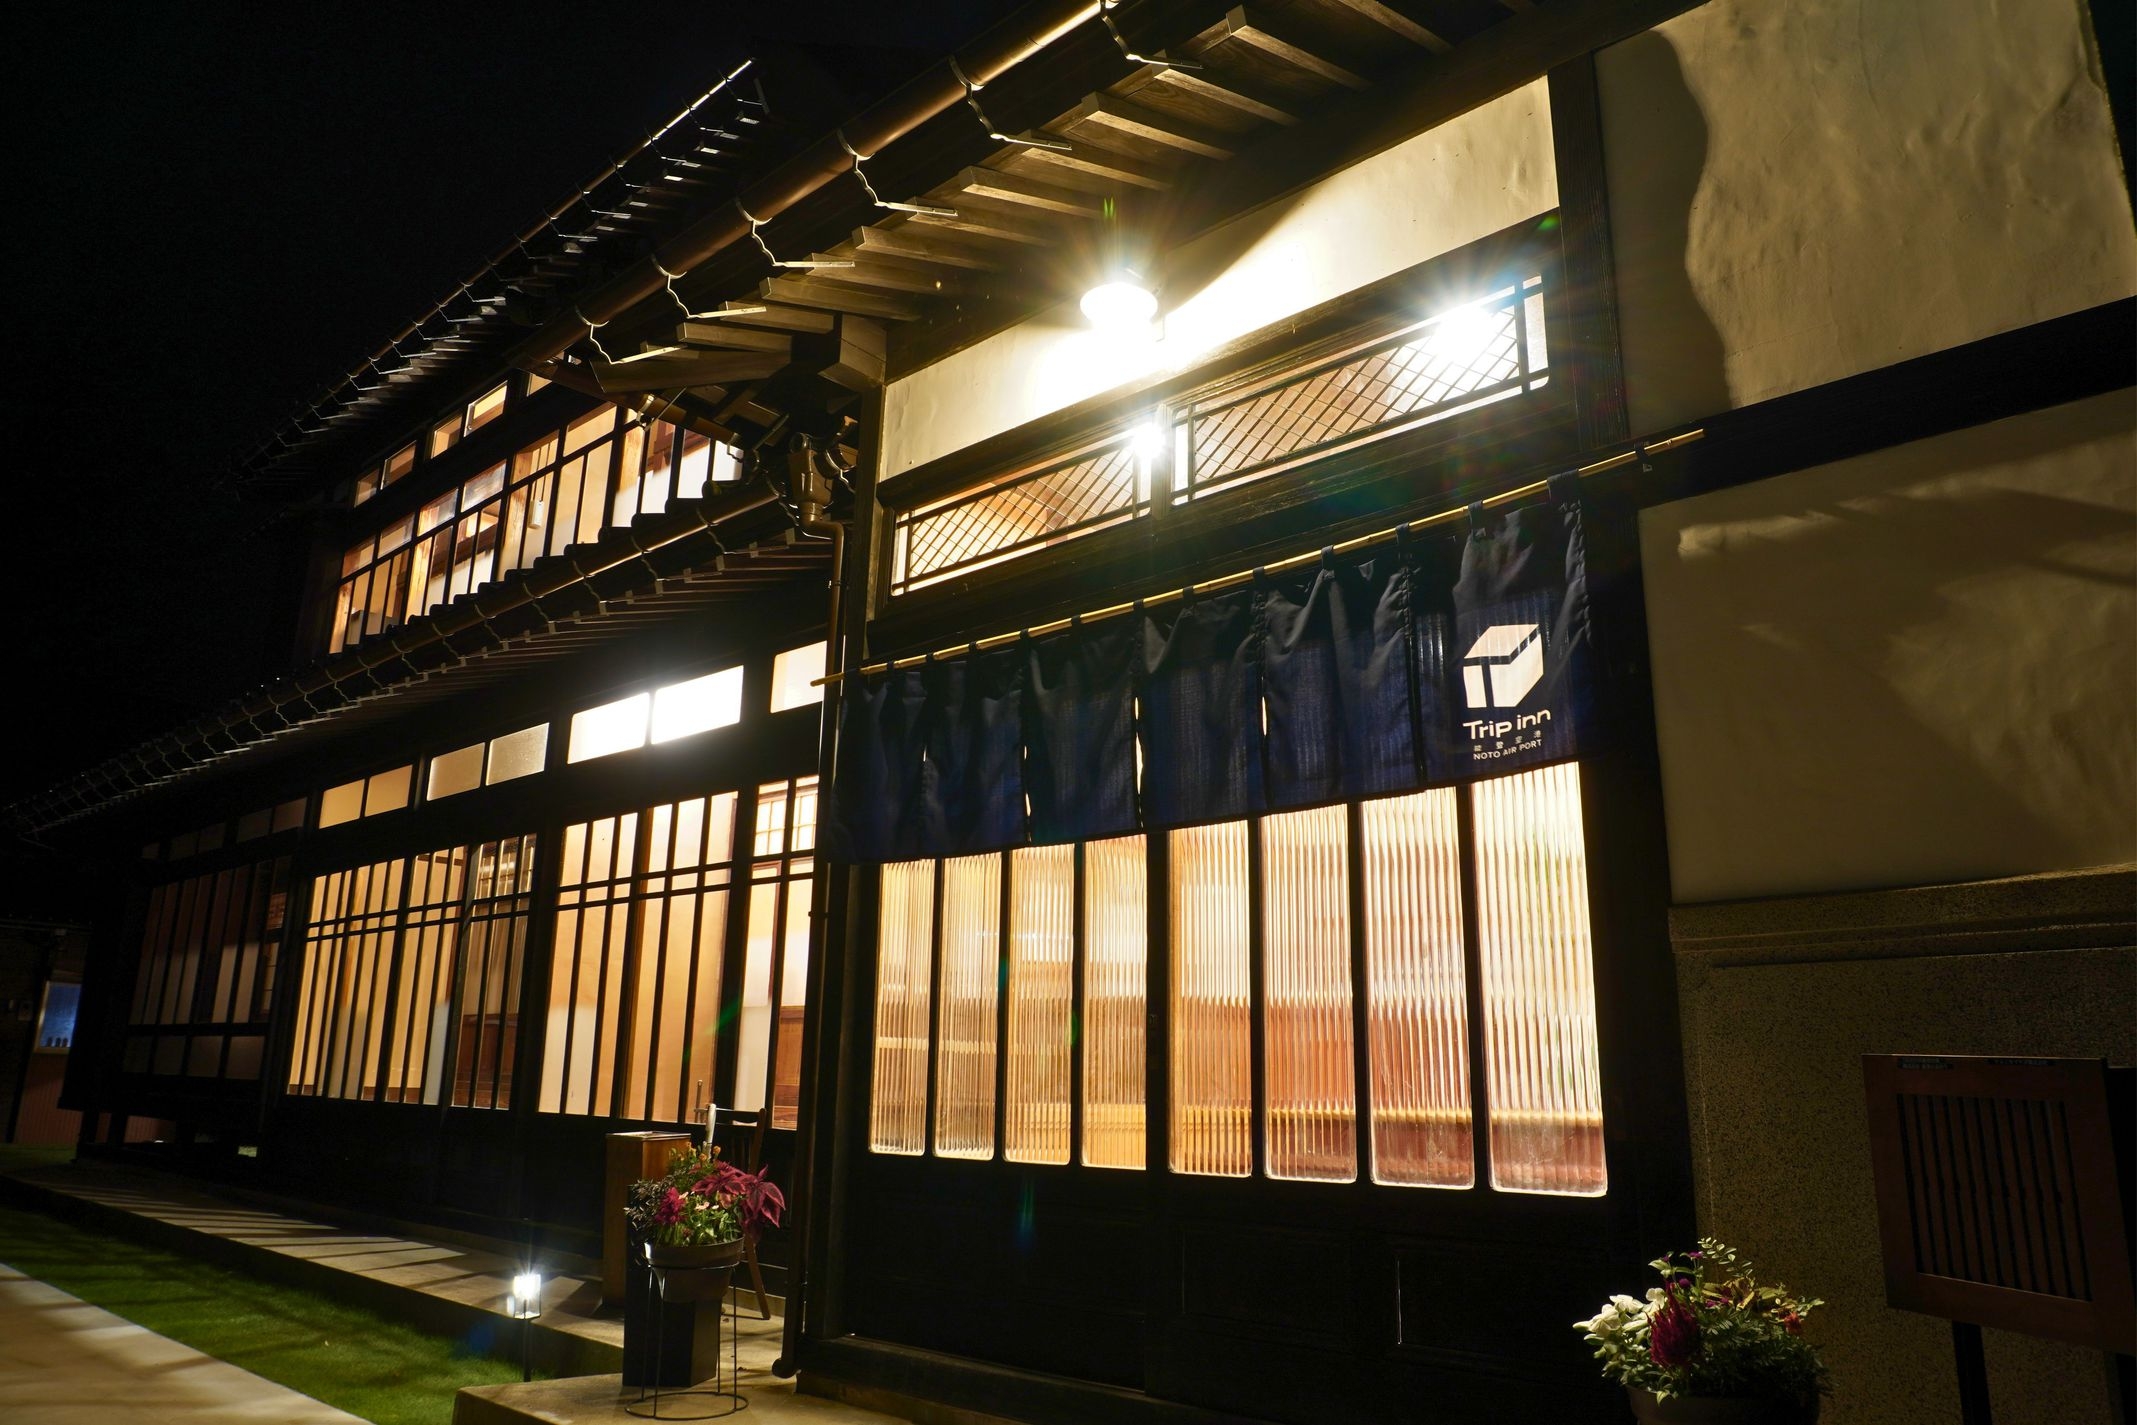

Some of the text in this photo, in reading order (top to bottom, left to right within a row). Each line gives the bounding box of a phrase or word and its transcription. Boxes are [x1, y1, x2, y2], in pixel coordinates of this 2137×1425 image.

[1463, 709, 1551, 739] Trip inn
[1473, 739, 1542, 760] NOTO AIR PORT
